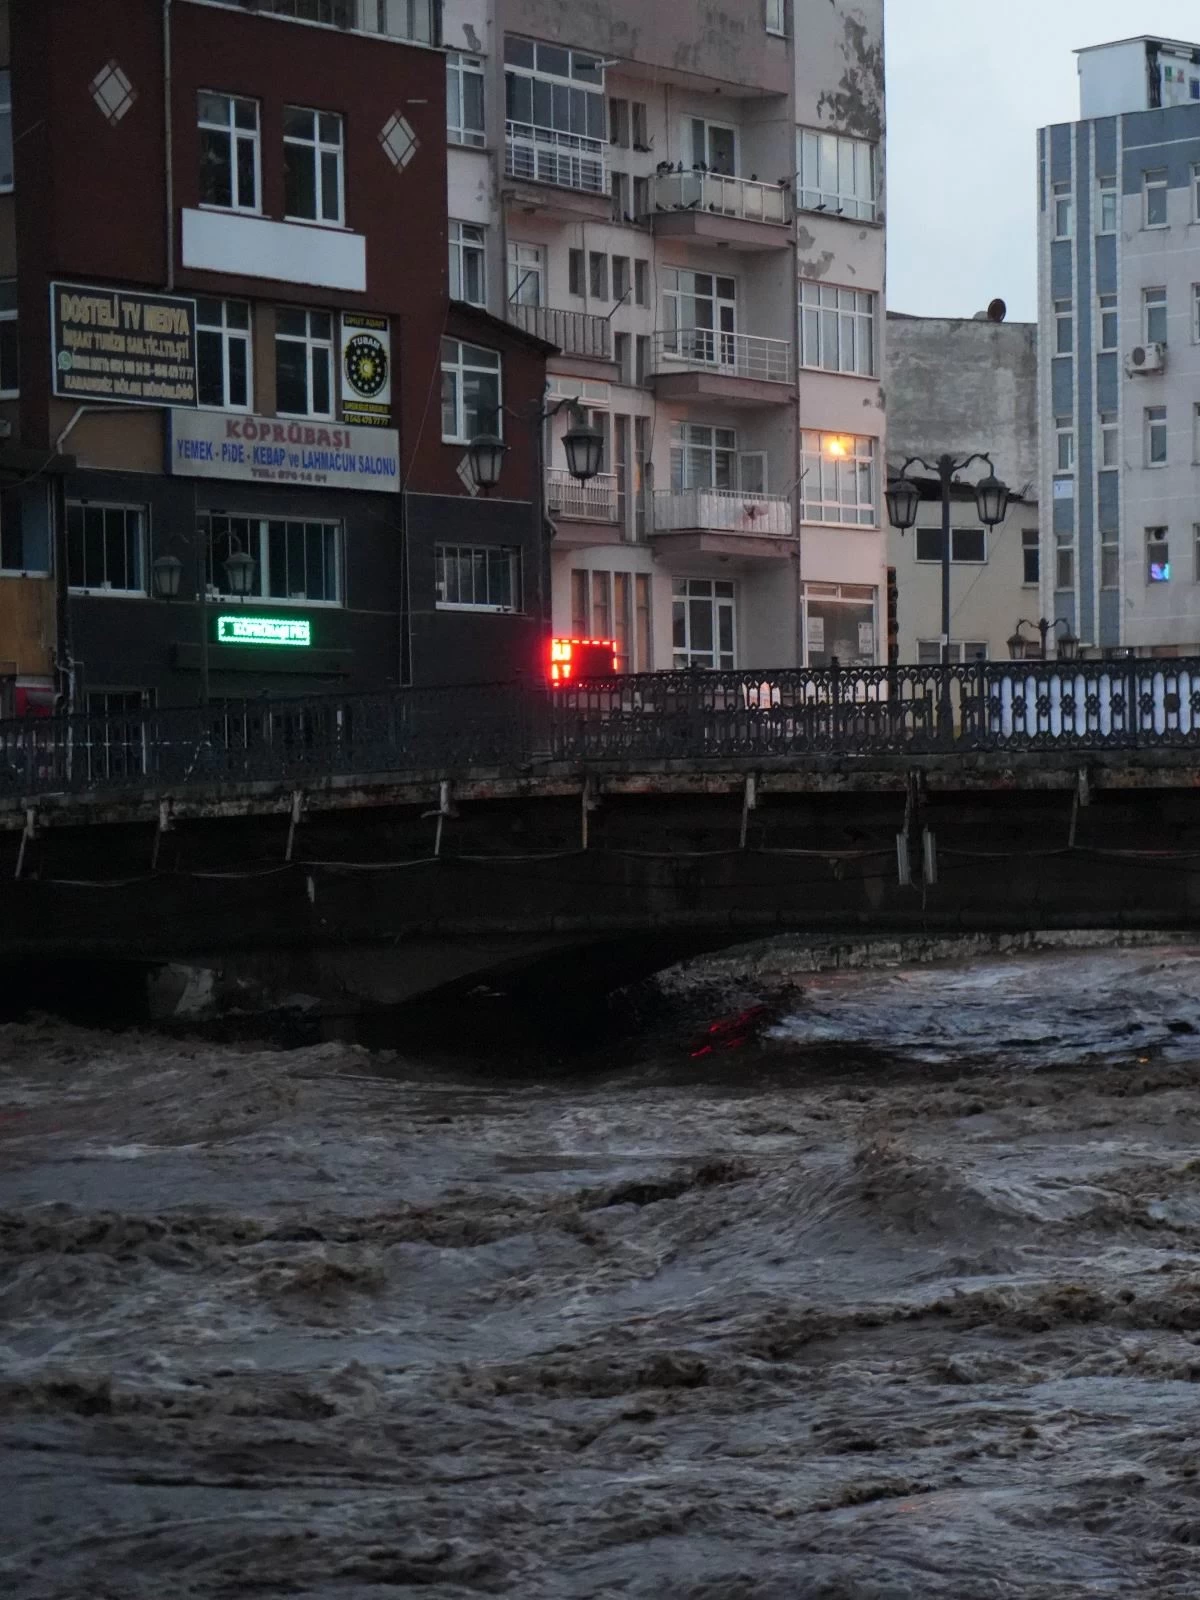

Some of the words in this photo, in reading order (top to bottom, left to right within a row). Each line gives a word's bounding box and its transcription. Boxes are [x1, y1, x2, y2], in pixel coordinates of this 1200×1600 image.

[122, 301, 141, 330] TV
[144, 305, 190, 336] MEDYA
[226, 418, 351, 452] KÖPRÜBAŞI
[177, 439, 213, 460] YEMEK
[253, 446, 286, 467] KEBAP
[288, 454, 300, 467] ve
[302, 454, 356, 472] LAHMACUN
[359, 458, 396, 477] SALONU
